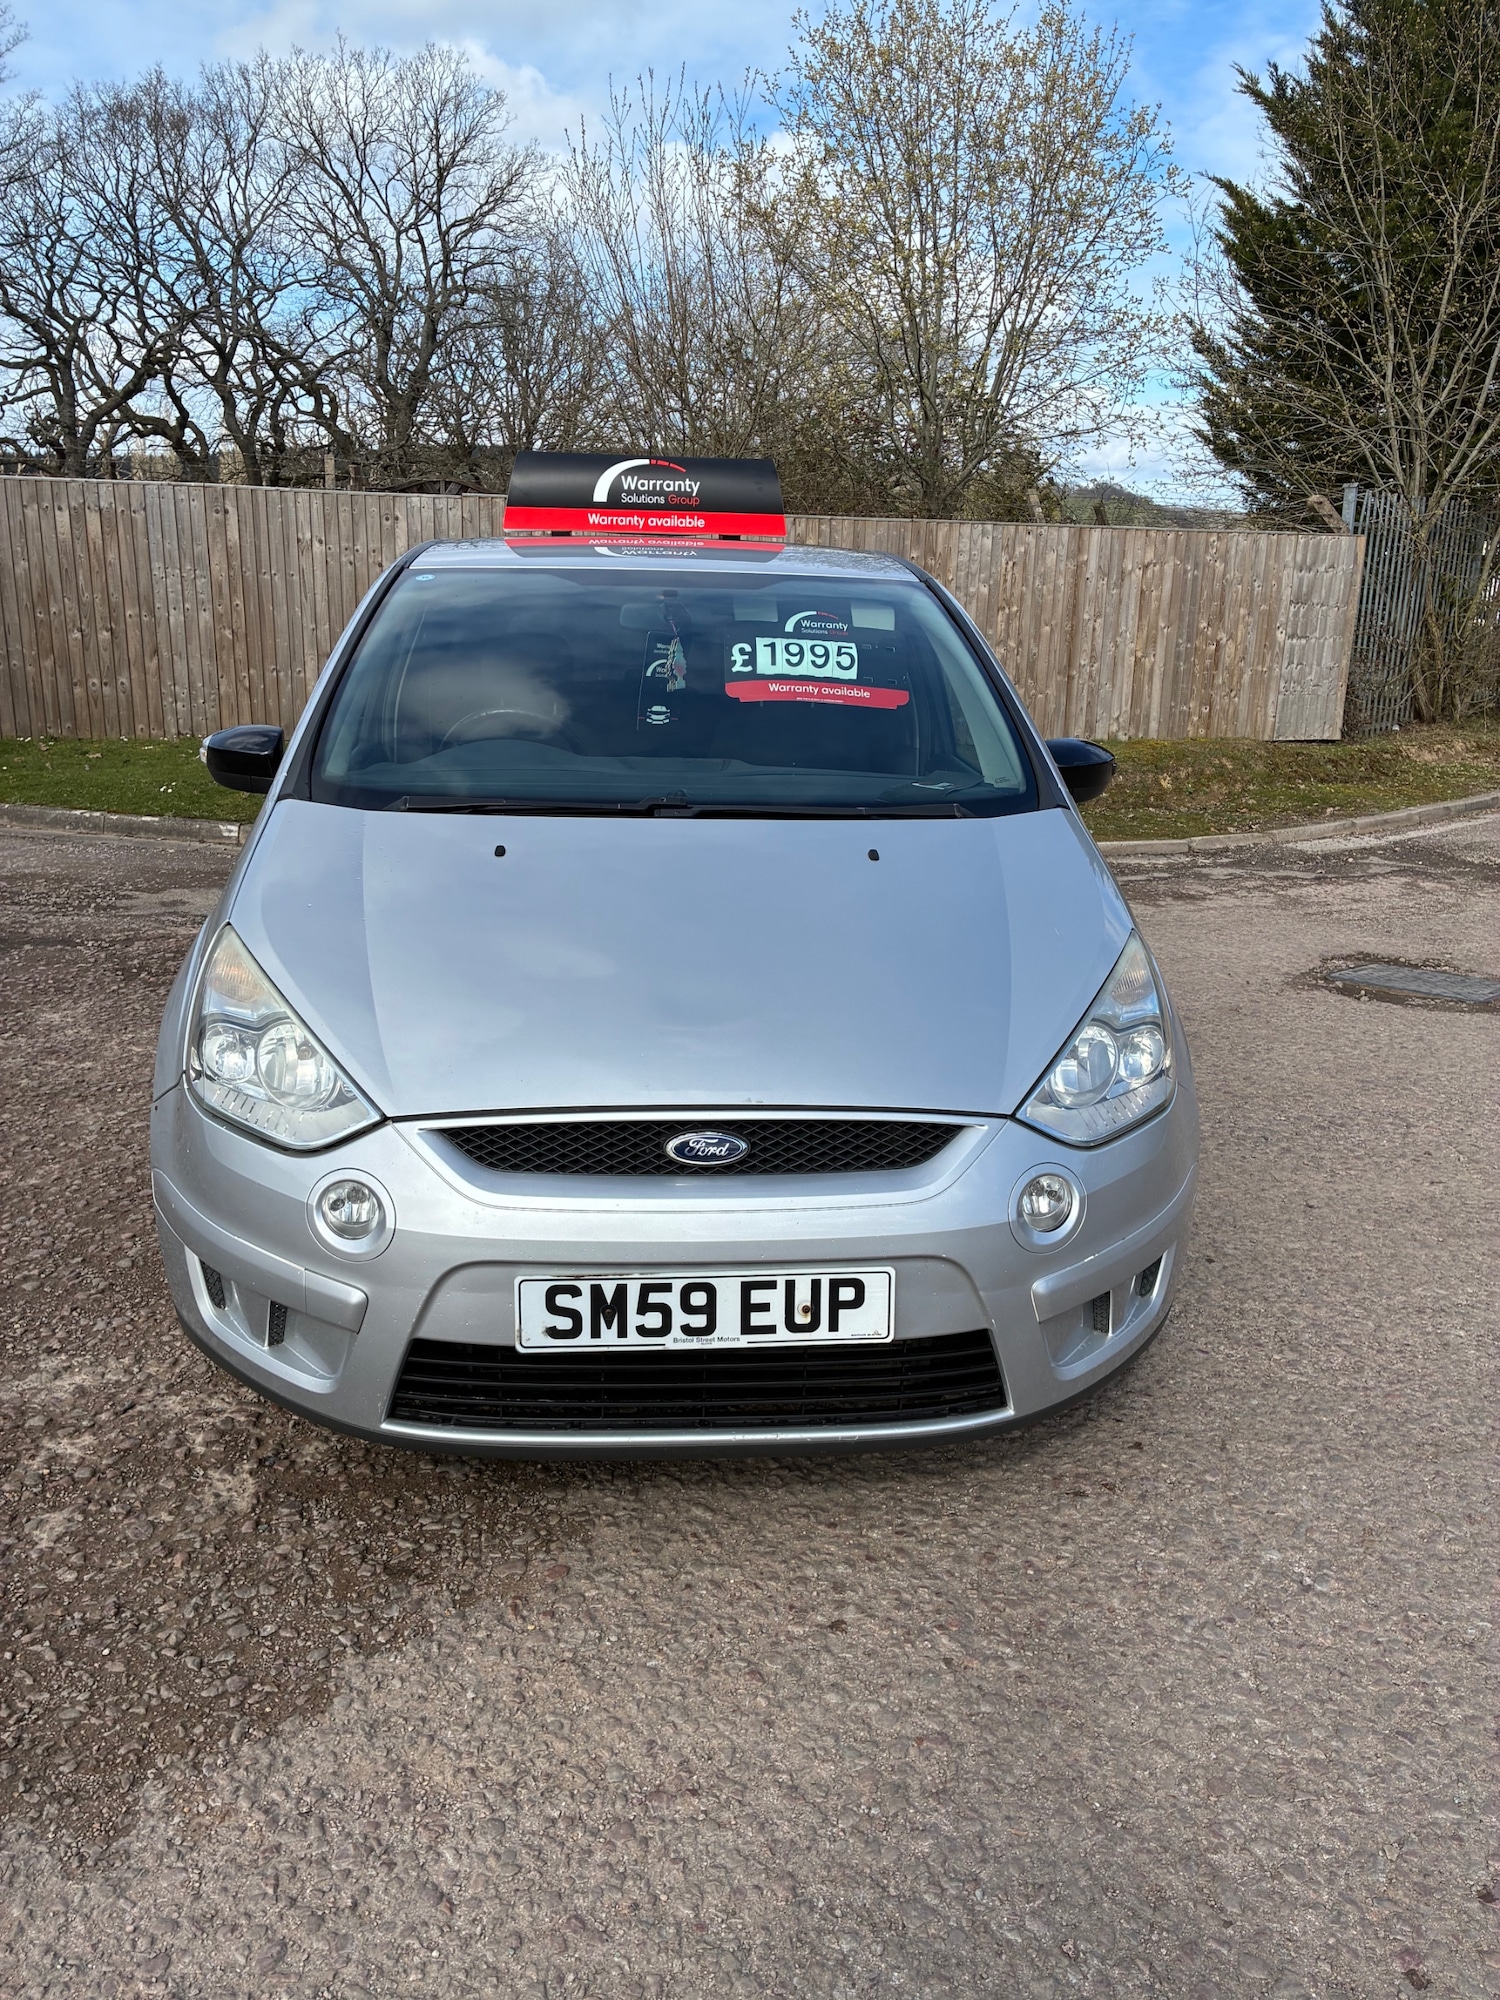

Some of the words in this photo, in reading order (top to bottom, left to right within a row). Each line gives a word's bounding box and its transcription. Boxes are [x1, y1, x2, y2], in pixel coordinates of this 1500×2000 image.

[621, 475, 700, 497] Warranty
[621, 493, 665, 504] Solutions
[667, 494, 700, 507] Group
[587, 513, 645, 529] Warranty
[647, 515, 706, 528] available
[800, 619, 848, 632] Warranty
[829, 629, 849, 637] Group
[768, 682, 819, 695] Warranty
[821, 687, 871, 699] available
[684, 1138, 730, 1157] Ford
[544, 1281, 718, 1341] SM59
[740, 1277, 866, 1336] EUP
